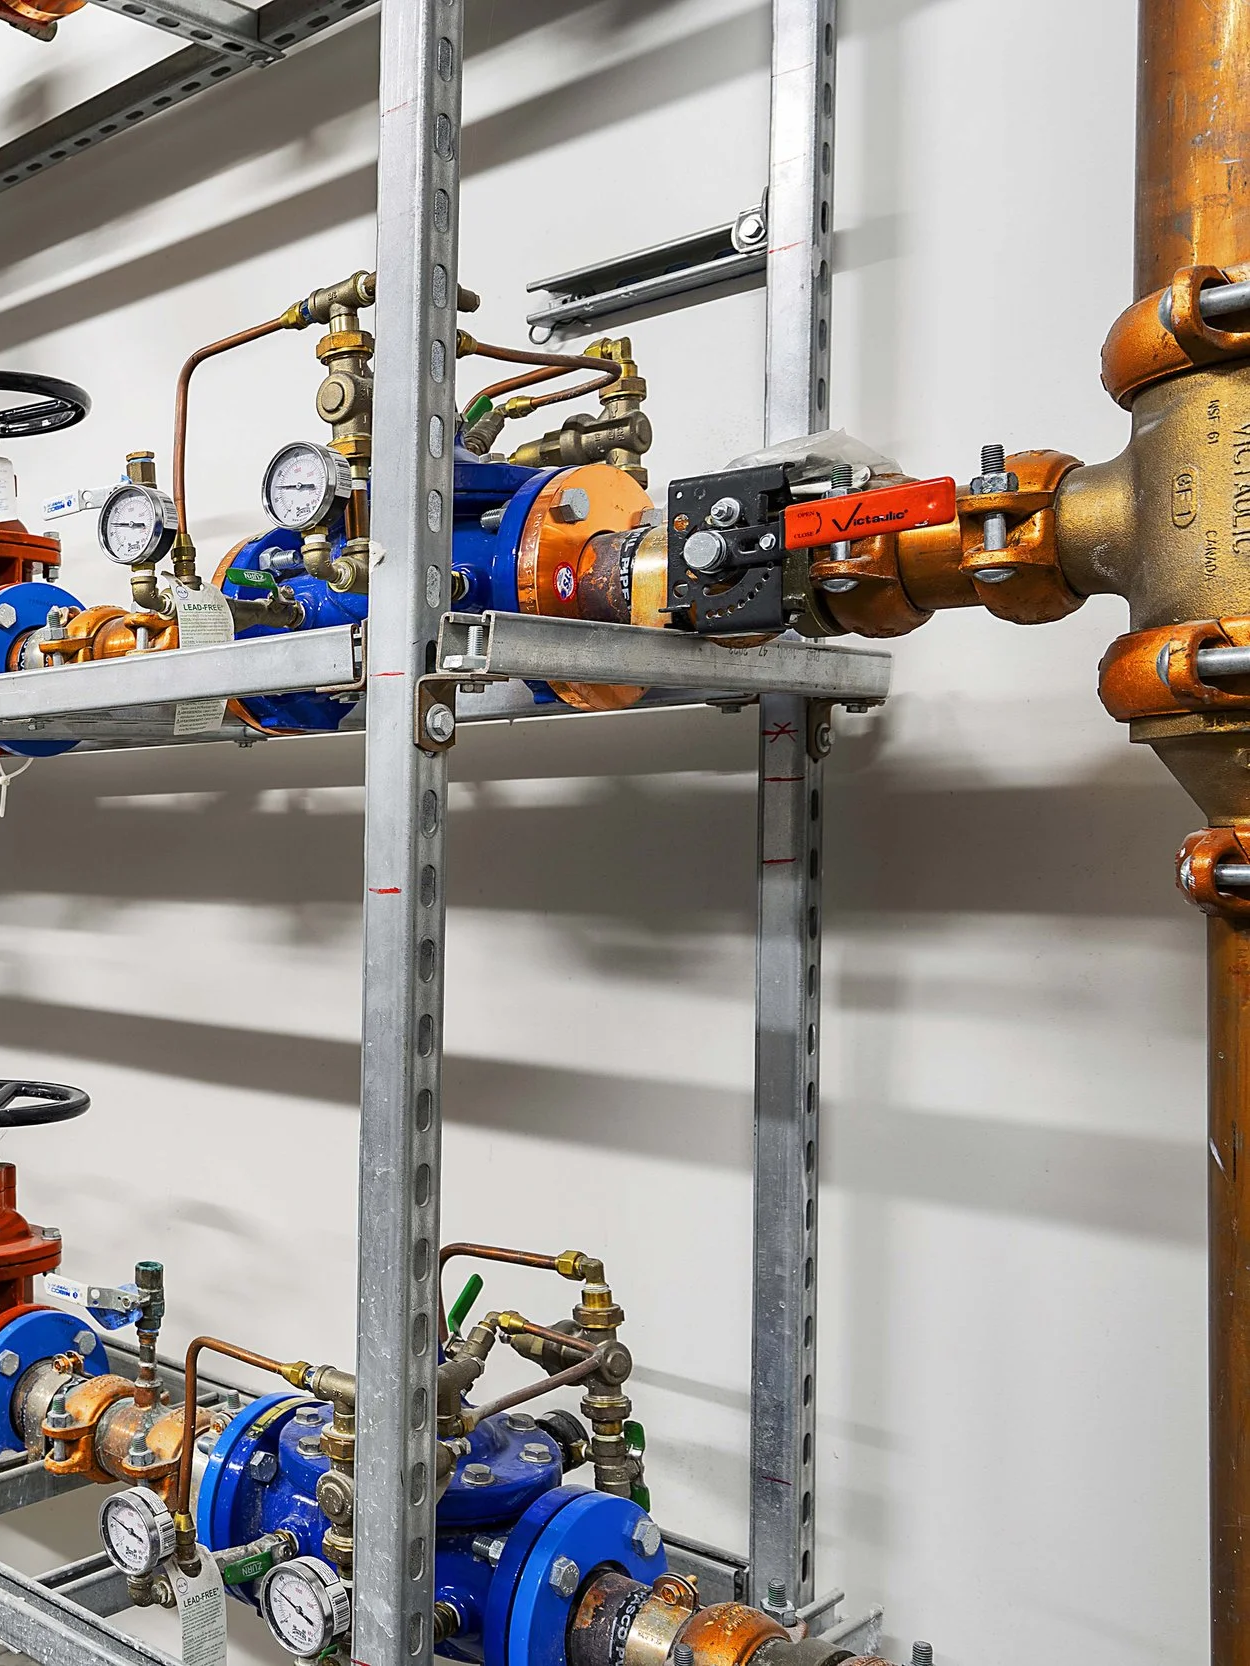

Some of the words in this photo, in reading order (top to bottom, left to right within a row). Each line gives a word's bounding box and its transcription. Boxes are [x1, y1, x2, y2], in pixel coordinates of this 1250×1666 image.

[797, 510, 815, 518] OPEN
[794, 531, 814, 539] CLOSE
[242, 1561, 263, 1577] ZURN
